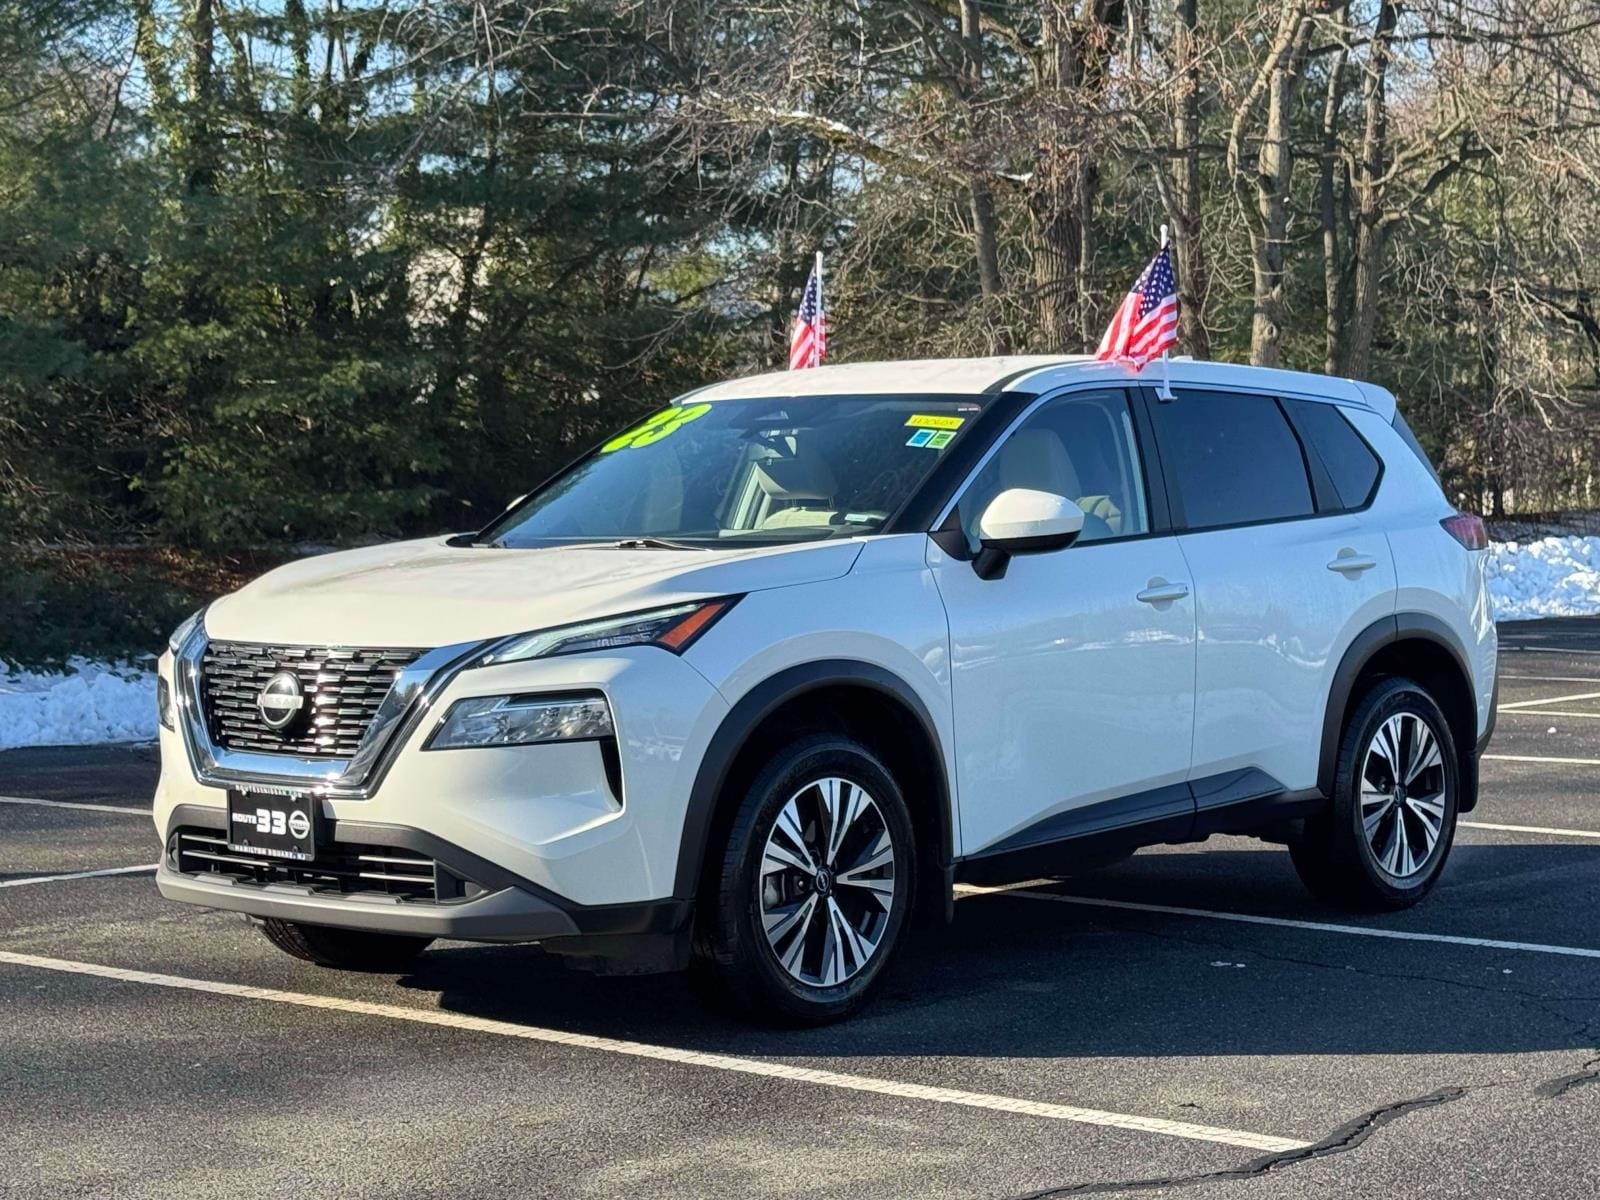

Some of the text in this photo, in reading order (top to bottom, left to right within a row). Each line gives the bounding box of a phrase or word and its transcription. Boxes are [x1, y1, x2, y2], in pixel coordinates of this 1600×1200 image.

[600, 403, 713, 453] 23
[232, 812, 257, 825] ROUTE
[256, 808, 286, 835] 33
